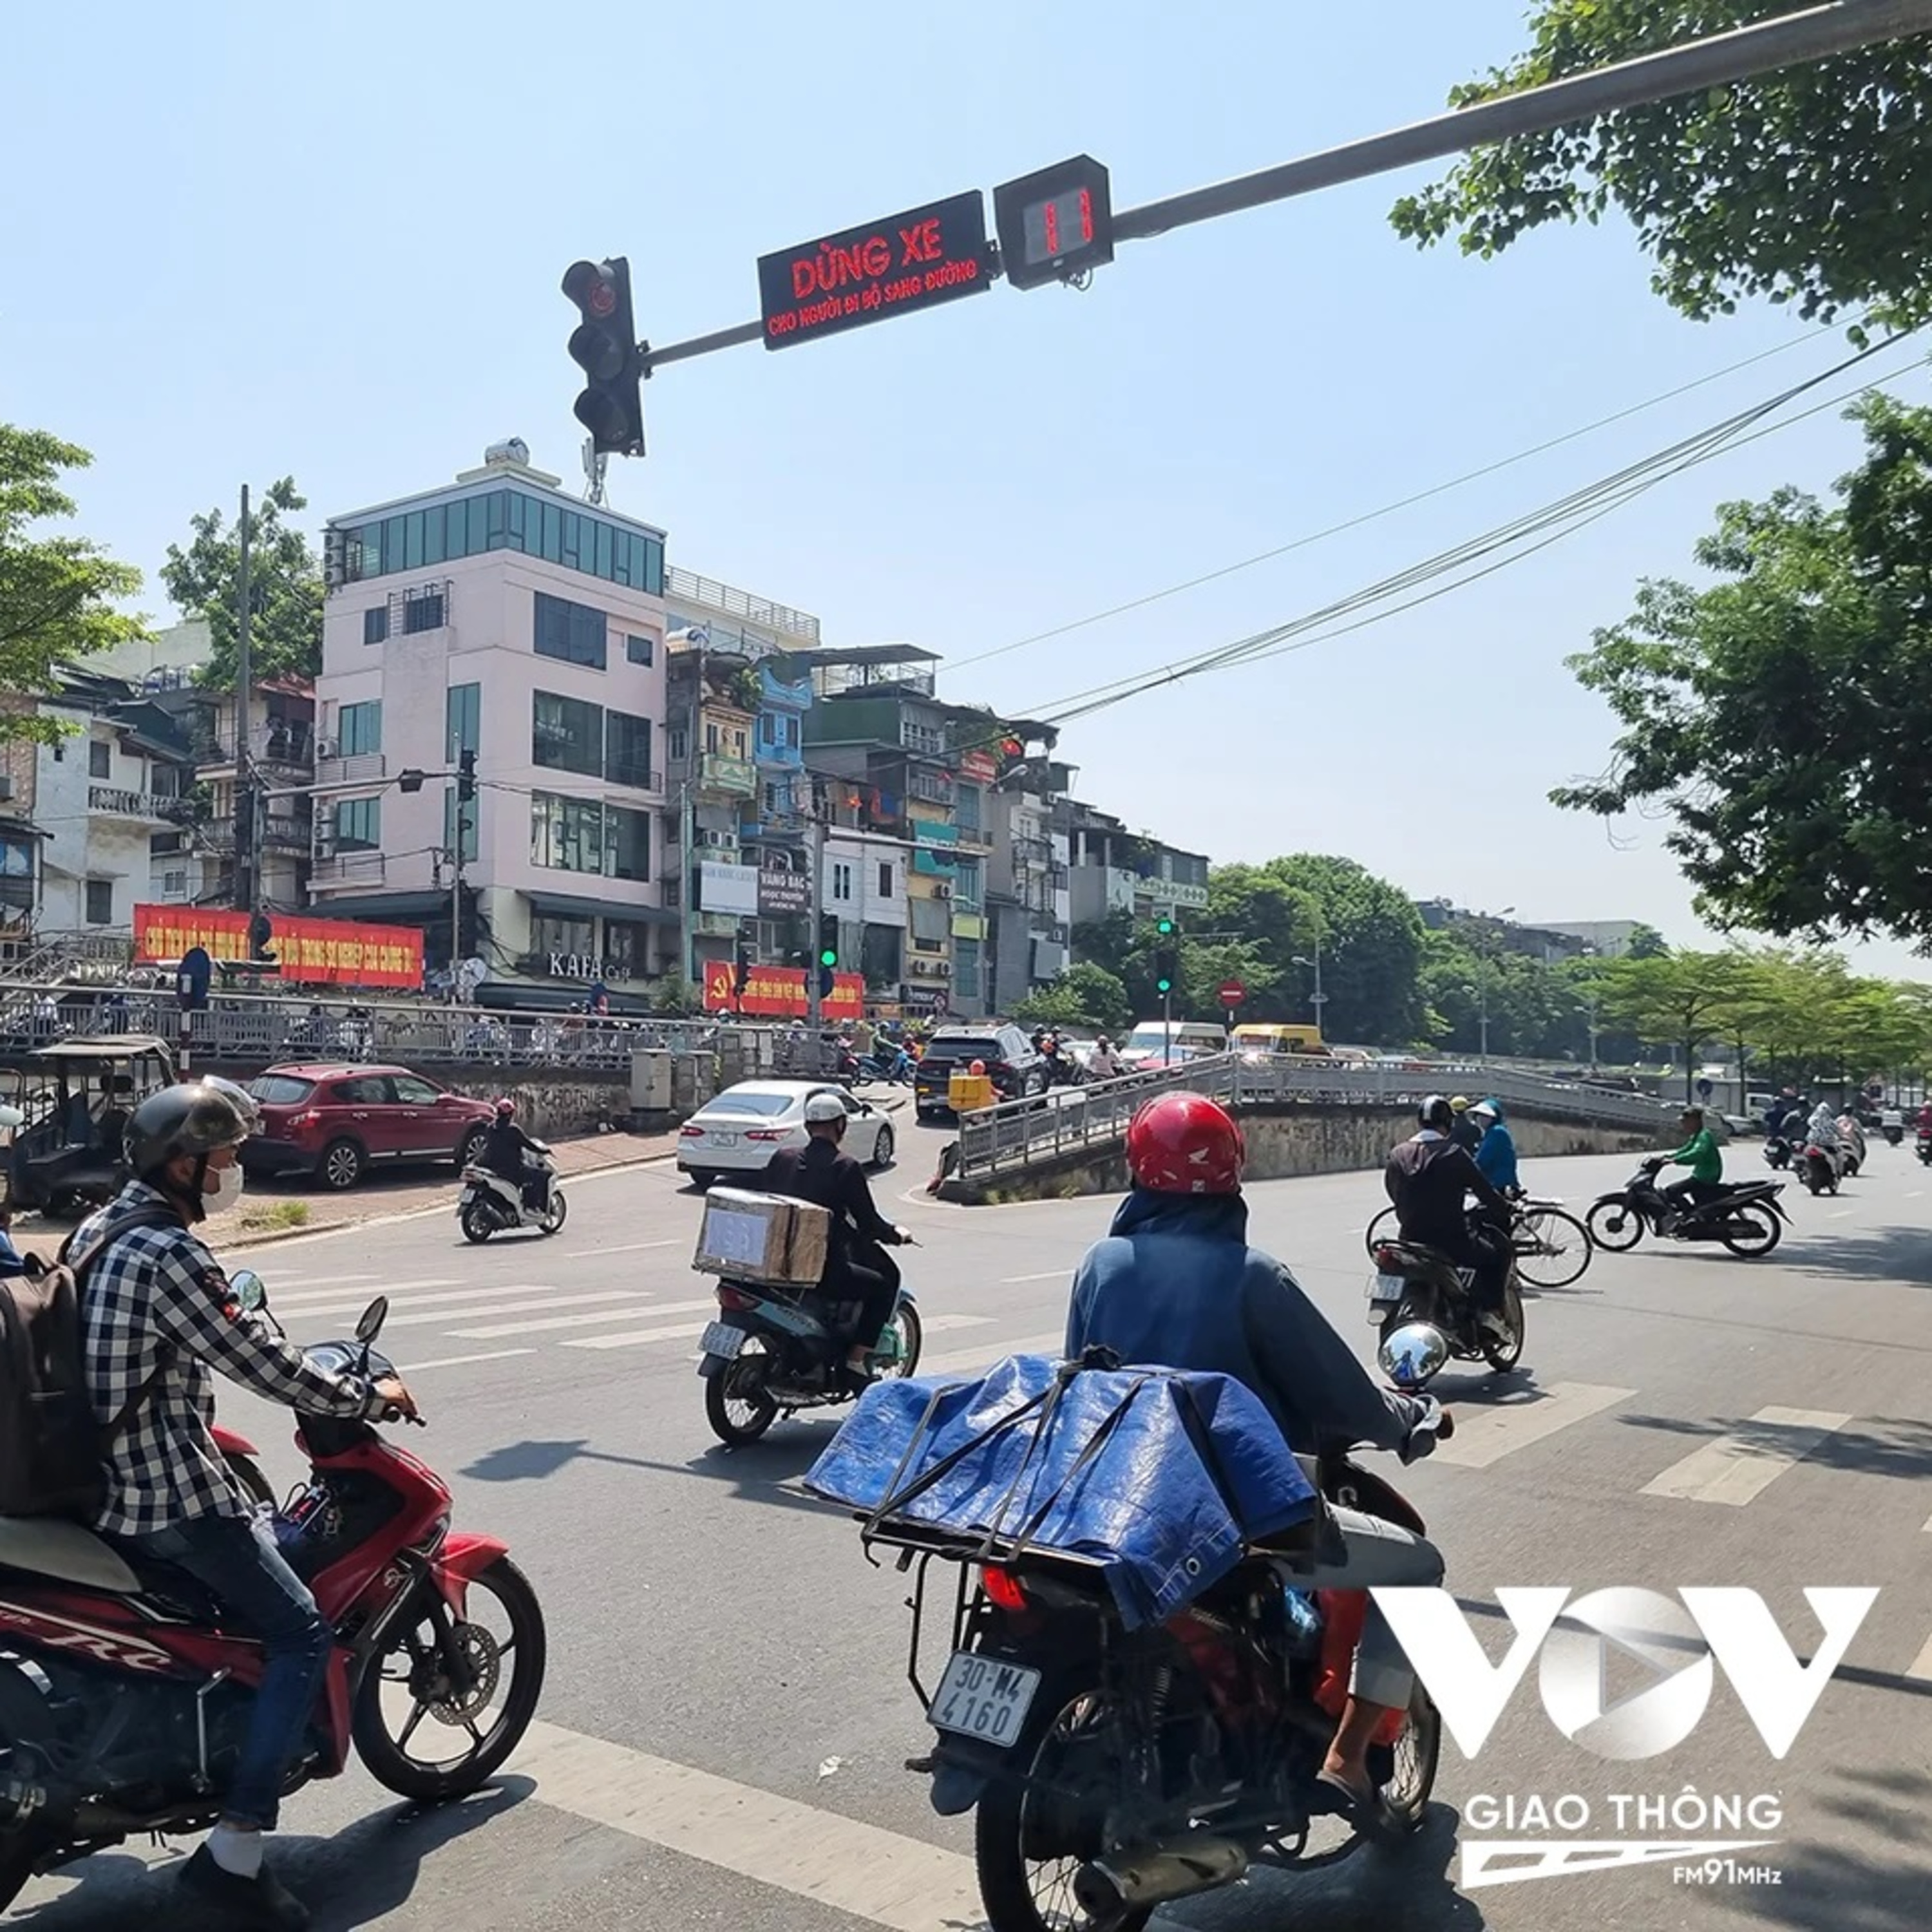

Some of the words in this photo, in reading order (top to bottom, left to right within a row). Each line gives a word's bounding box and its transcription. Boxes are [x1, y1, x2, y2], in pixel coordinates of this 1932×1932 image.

[1045, 187, 1094, 256] 11
[792, 236, 891, 299] DỪNG
[899, 218, 942, 267] XE
[768, 312, 797, 336] CHO
[844, 293, 860, 314] ĐI
[862, 282, 882, 311] BỘ
[884, 276, 922, 302] SANG
[549, 952, 603, 979] KAFA
[942, 1692, 1011, 1737] 4160
